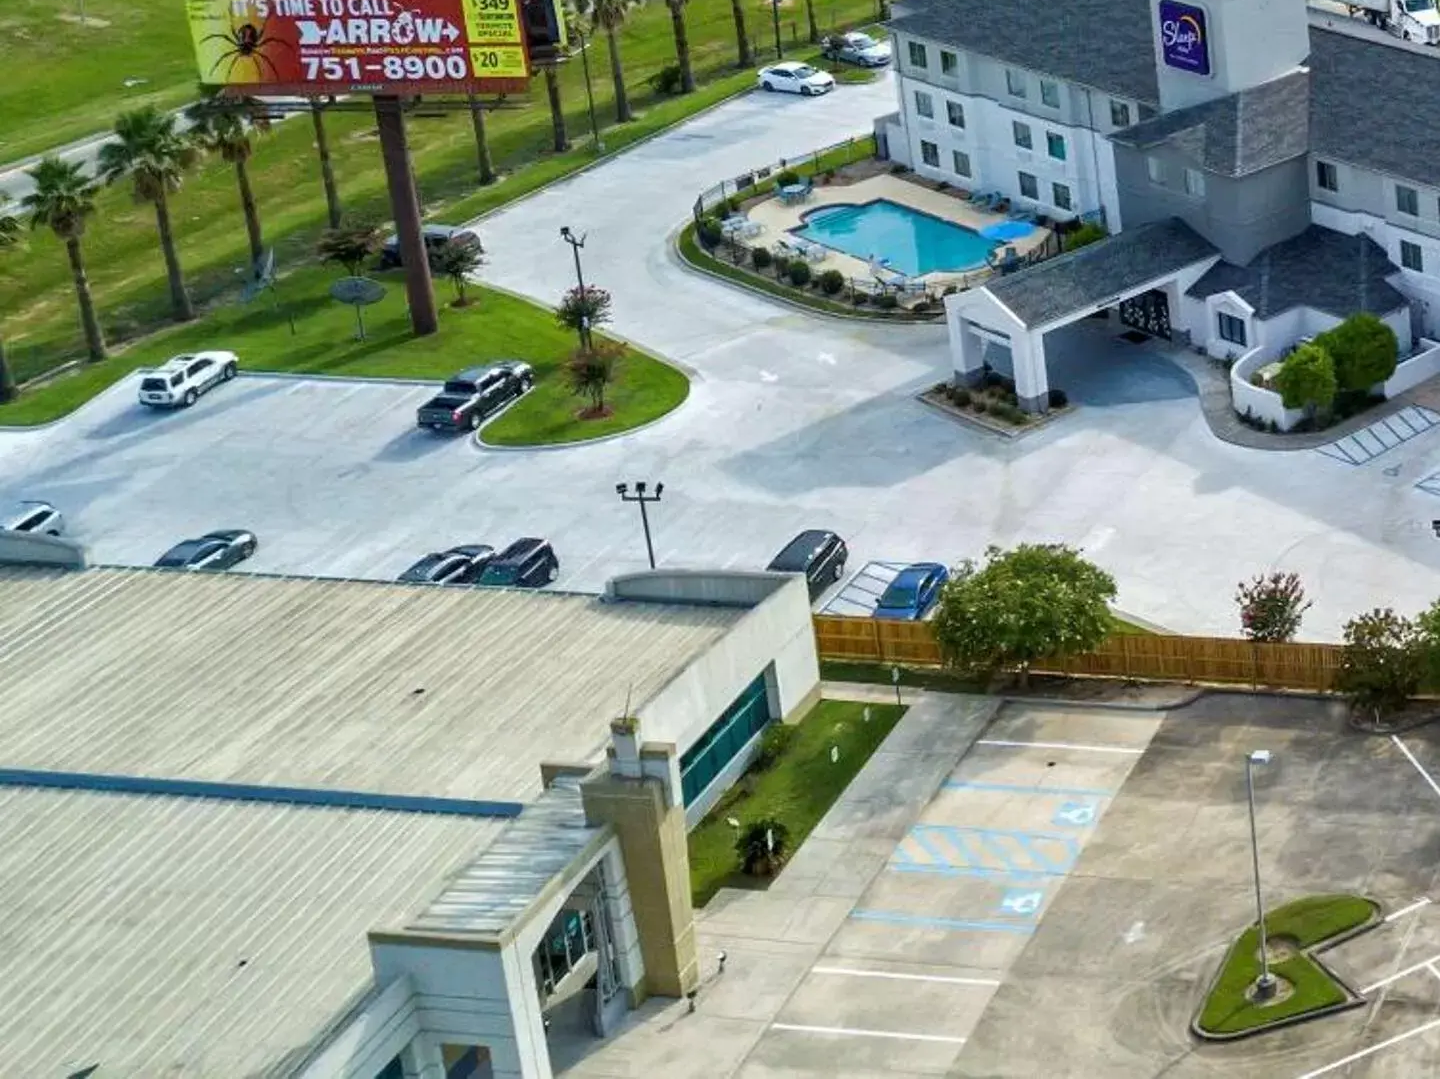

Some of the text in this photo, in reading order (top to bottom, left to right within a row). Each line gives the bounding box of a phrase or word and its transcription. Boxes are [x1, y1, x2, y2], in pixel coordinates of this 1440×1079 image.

[325, 15, 444, 45] ARROW
[1163, 20, 1197, 50] Sleep
[301, 56, 468, 80] 751-8900
